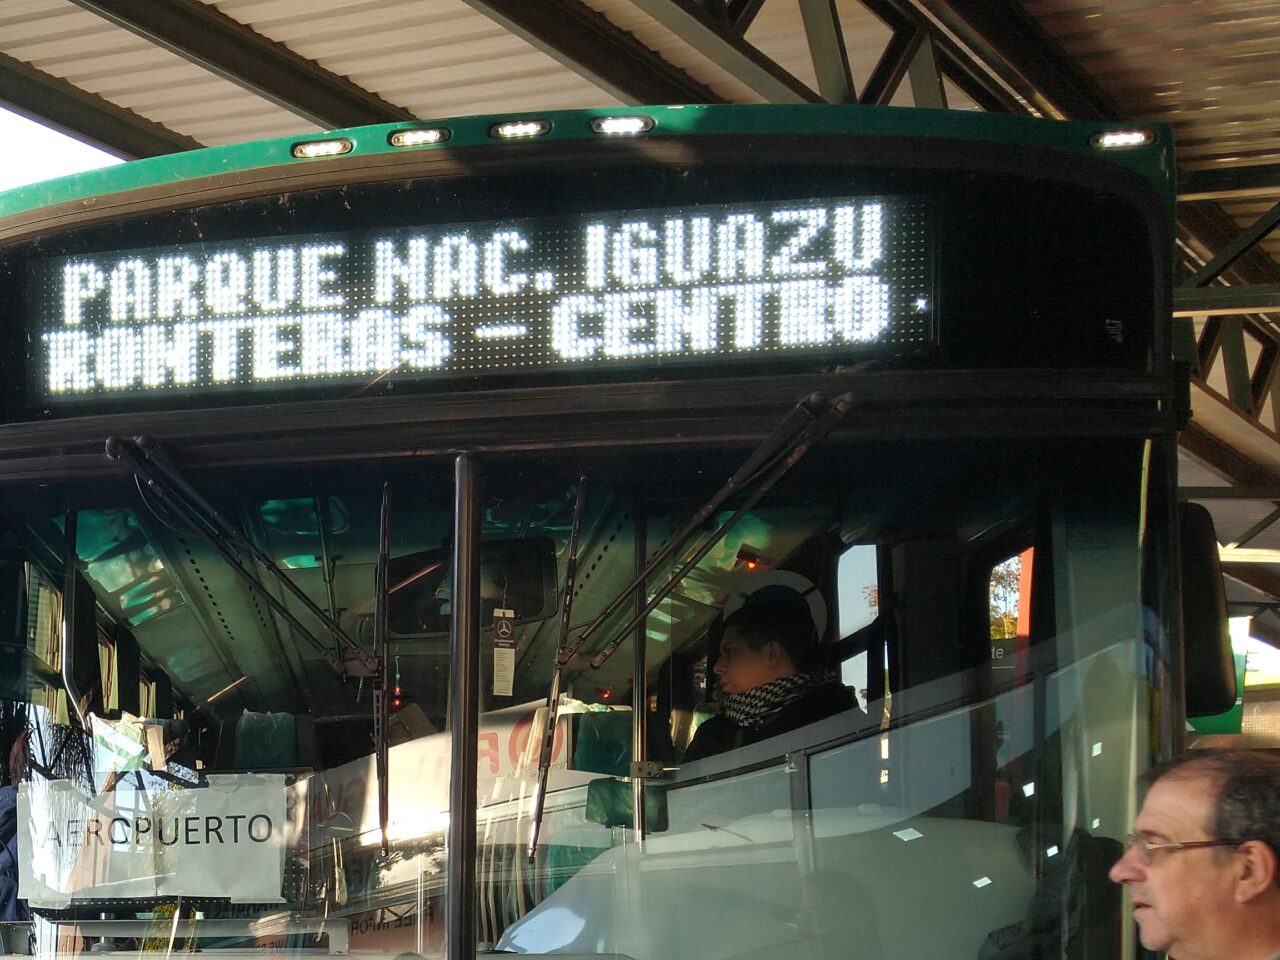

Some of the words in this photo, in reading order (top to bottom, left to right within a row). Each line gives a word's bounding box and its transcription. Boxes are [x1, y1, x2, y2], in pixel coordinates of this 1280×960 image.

[61, 242, 348, 326] PARQUE
[374, 230, 554, 302] NAC.
[585, 202, 885, 289] IGUAZU
[551, 274, 890, 360] CENTRO
[41, 813, 273, 848] AEROPUERTO
